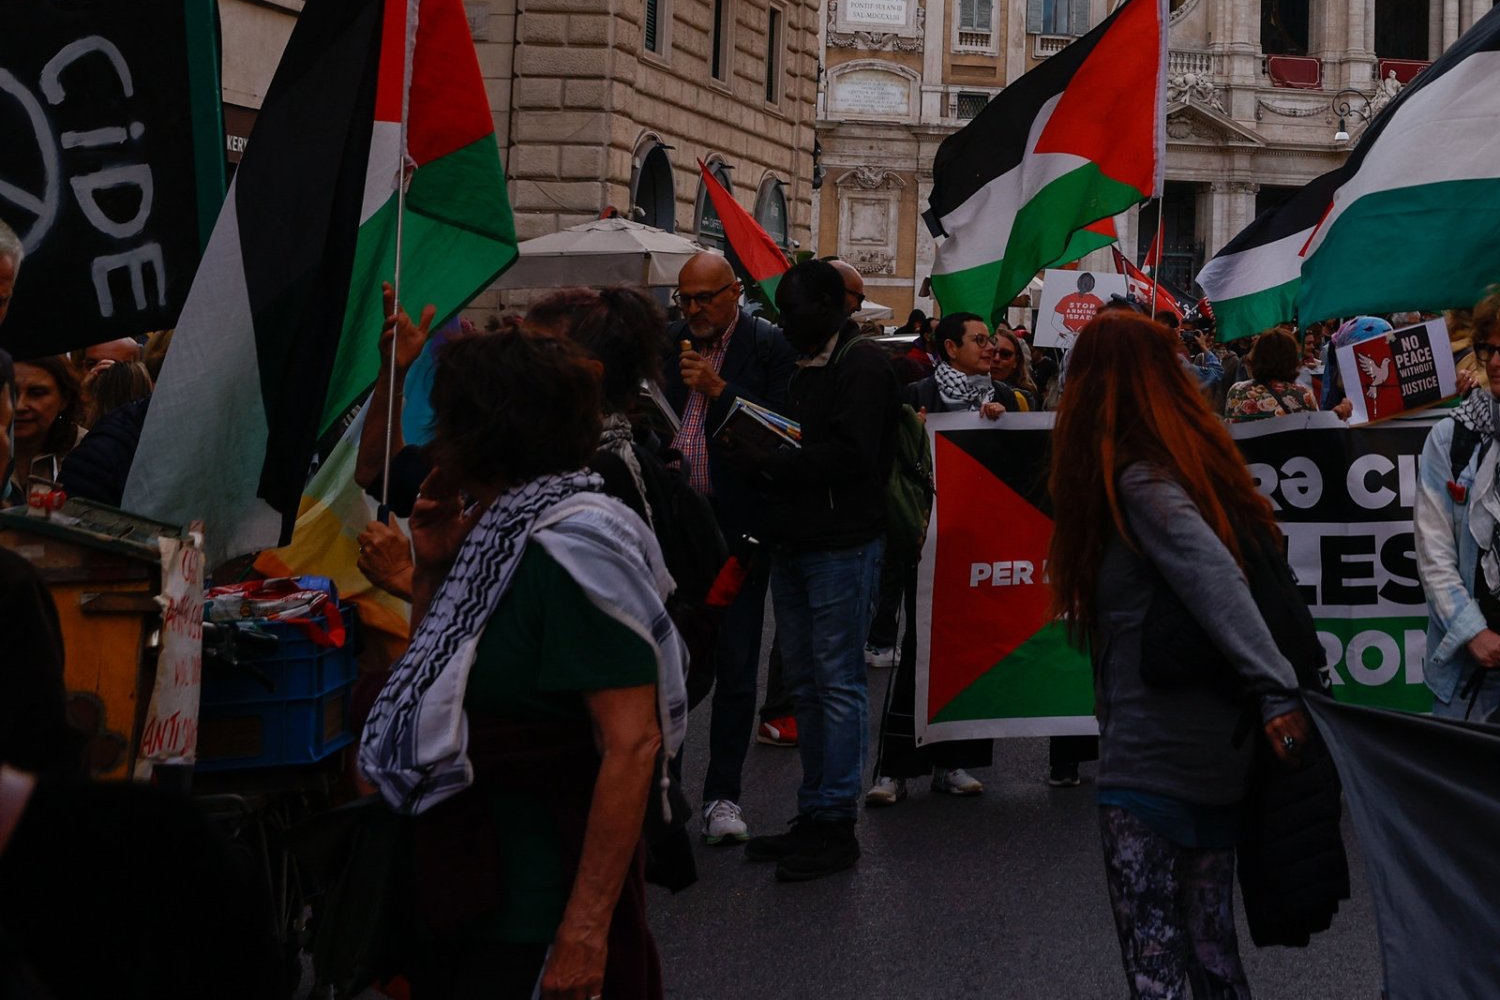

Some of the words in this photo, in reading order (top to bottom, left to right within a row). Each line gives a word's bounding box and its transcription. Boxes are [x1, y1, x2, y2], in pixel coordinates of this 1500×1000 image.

[1066, 308, 1097, 316] ARMING
[1069, 302, 1096, 310] STOP
[1400, 335, 1420, 352] NO
[1395, 347, 1432, 368] PEACE
[1399, 361, 1433, 378] WITHOUT
[1401, 375, 1438, 397] JUSTICE
[969, 560, 1034, 588] PER
